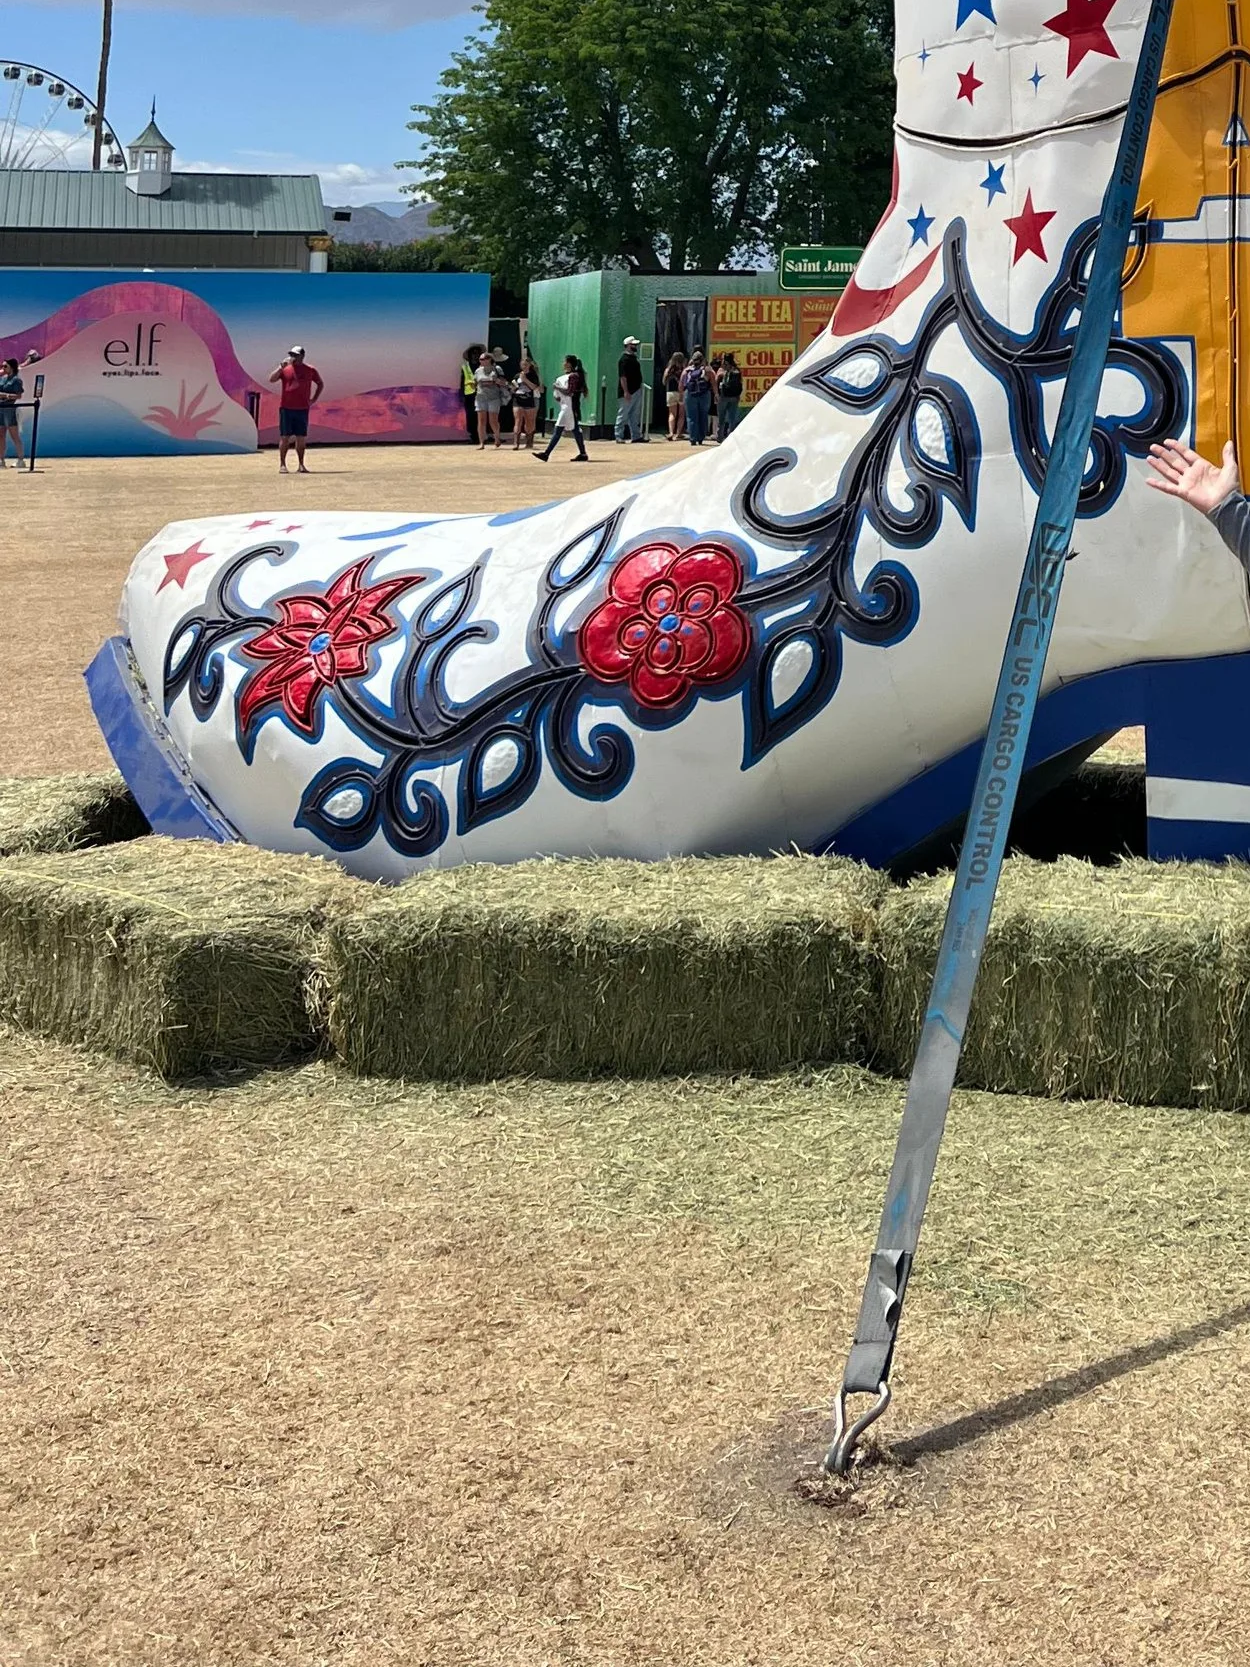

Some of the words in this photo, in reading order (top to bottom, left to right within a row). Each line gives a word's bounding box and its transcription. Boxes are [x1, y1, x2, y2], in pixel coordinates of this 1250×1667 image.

[785, 258, 821, 272] Saint
[825, 260, 858, 272] Jam
[716, 300, 757, 322] FREE
[761, 300, 792, 322] TEA
[746, 349, 793, 366] COLD
[1011, 657, 1034, 686] US
[992, 692, 1026, 772] CARGO
[965, 777, 1007, 891] CONTROL
